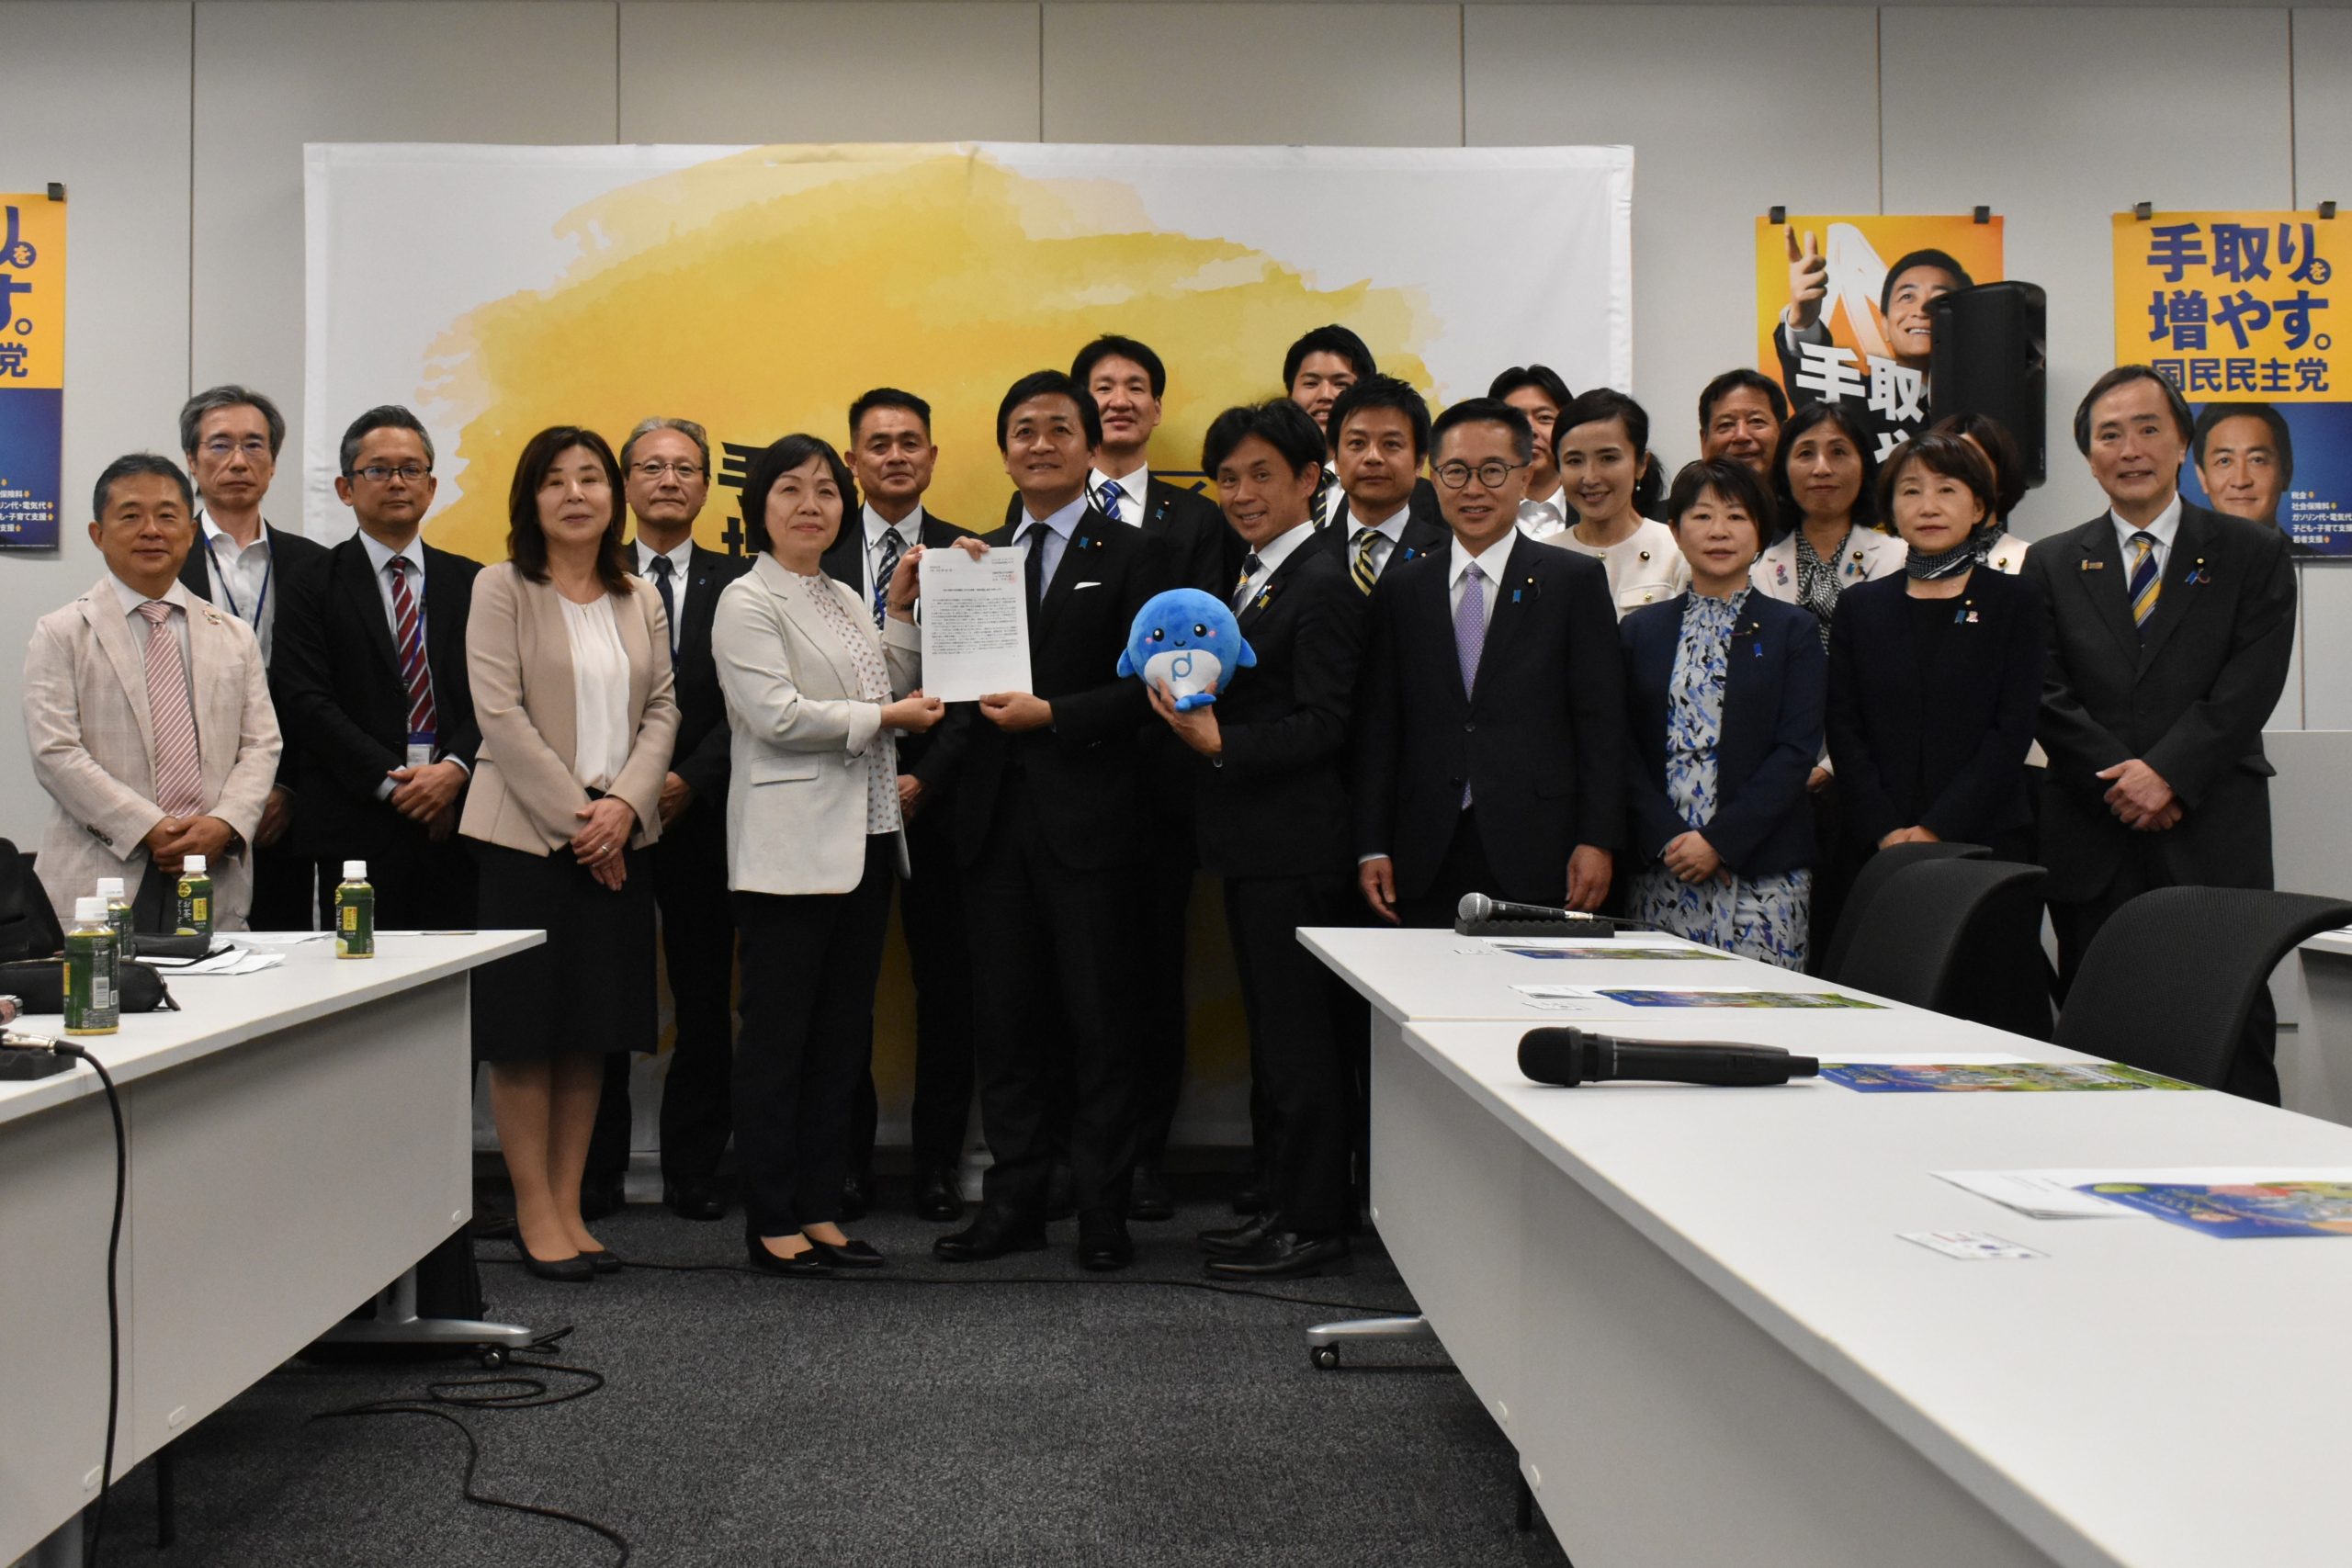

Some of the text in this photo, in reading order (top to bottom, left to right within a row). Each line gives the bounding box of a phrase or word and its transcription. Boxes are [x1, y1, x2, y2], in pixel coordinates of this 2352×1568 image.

[2147, 223, 2332, 285] 手取りを
[2148, 289, 2332, 351] 増やす。
[0, 343, 28, 378] 党
[2152, 357, 2329, 392] 国民民主党
